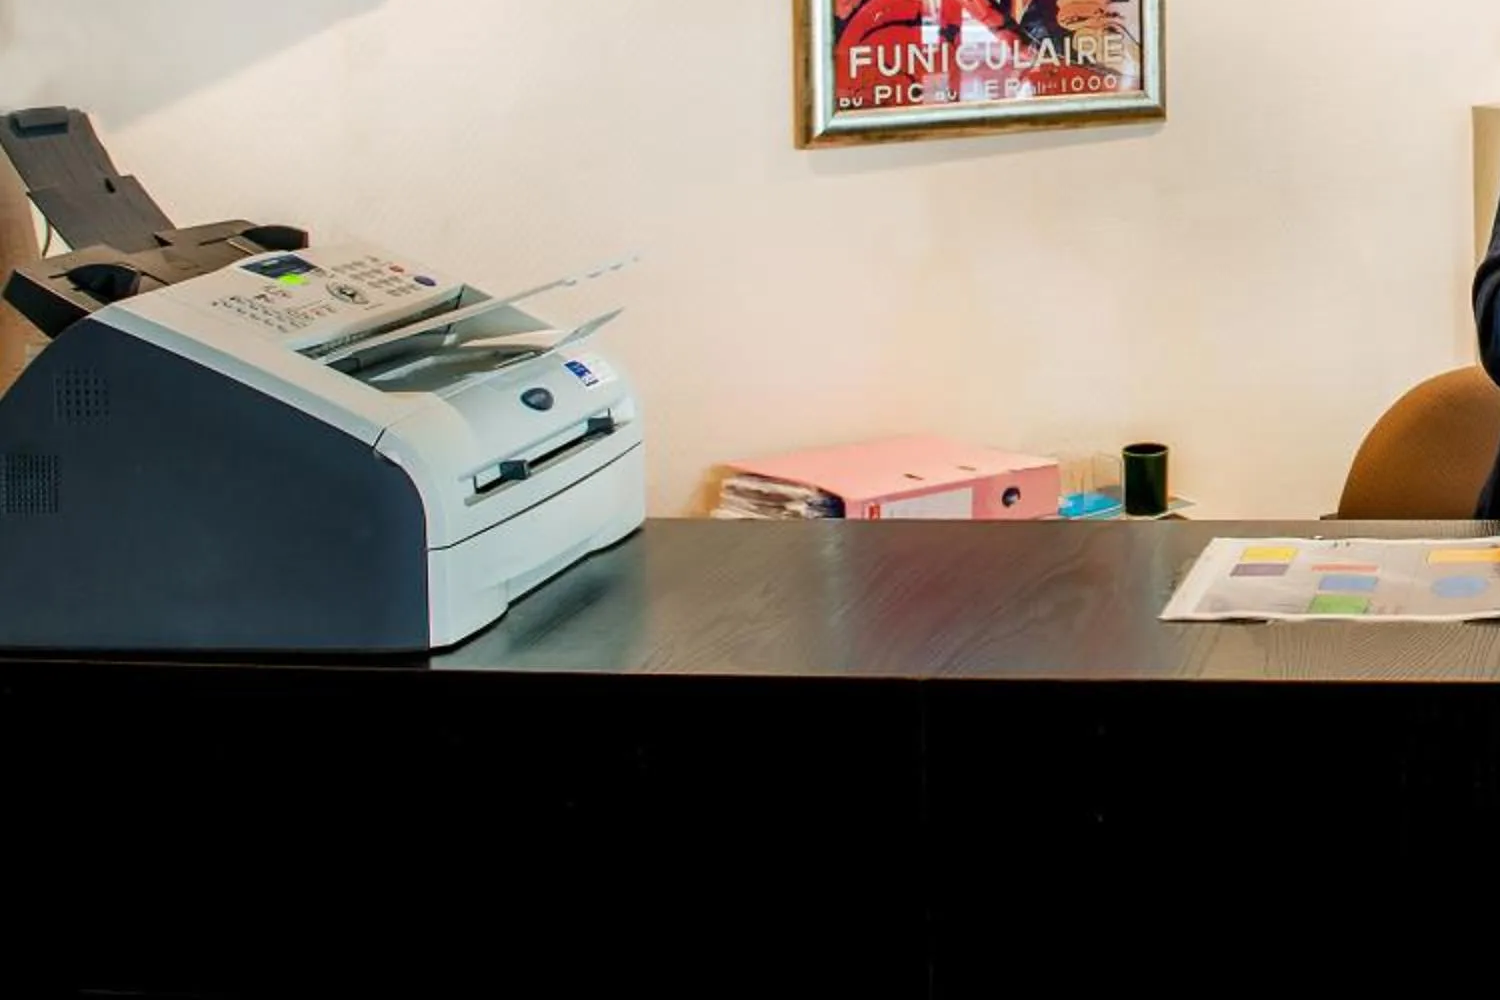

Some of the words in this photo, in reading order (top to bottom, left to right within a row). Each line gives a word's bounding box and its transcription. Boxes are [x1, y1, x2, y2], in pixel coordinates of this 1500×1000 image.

[849, 34, 1124, 79] FUNICULAIRE
[874, 83, 925, 105] PIC
[1061, 74, 1118, 93] 1000
